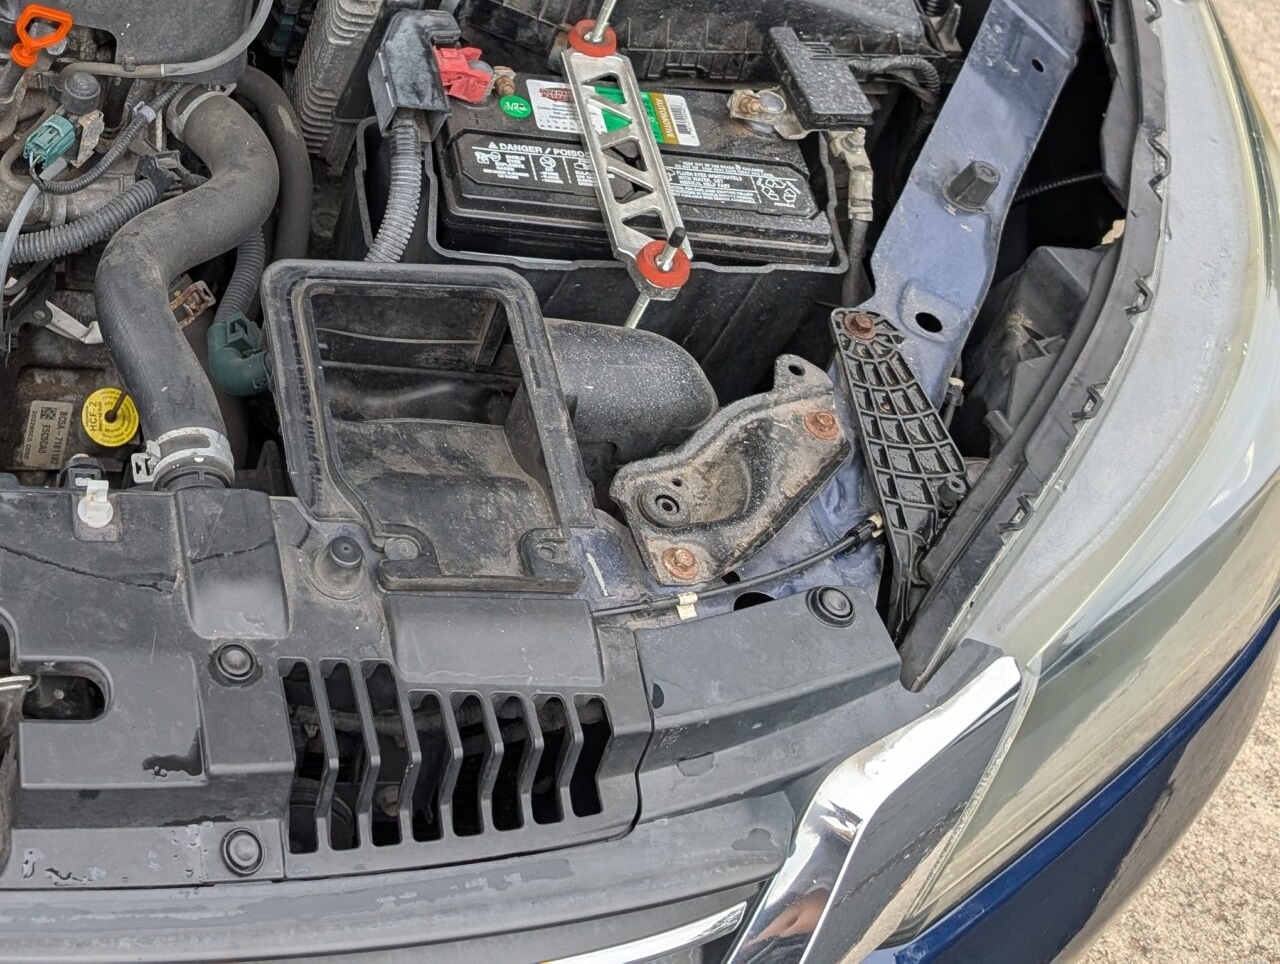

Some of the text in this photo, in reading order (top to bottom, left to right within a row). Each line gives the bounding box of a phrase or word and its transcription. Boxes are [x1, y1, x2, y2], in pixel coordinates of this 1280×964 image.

[655, 98, 675, 139] AUTOMOTIVE
[500, 143, 543, 154] DANGER
[89, 401, 98, 432] HCF-2
